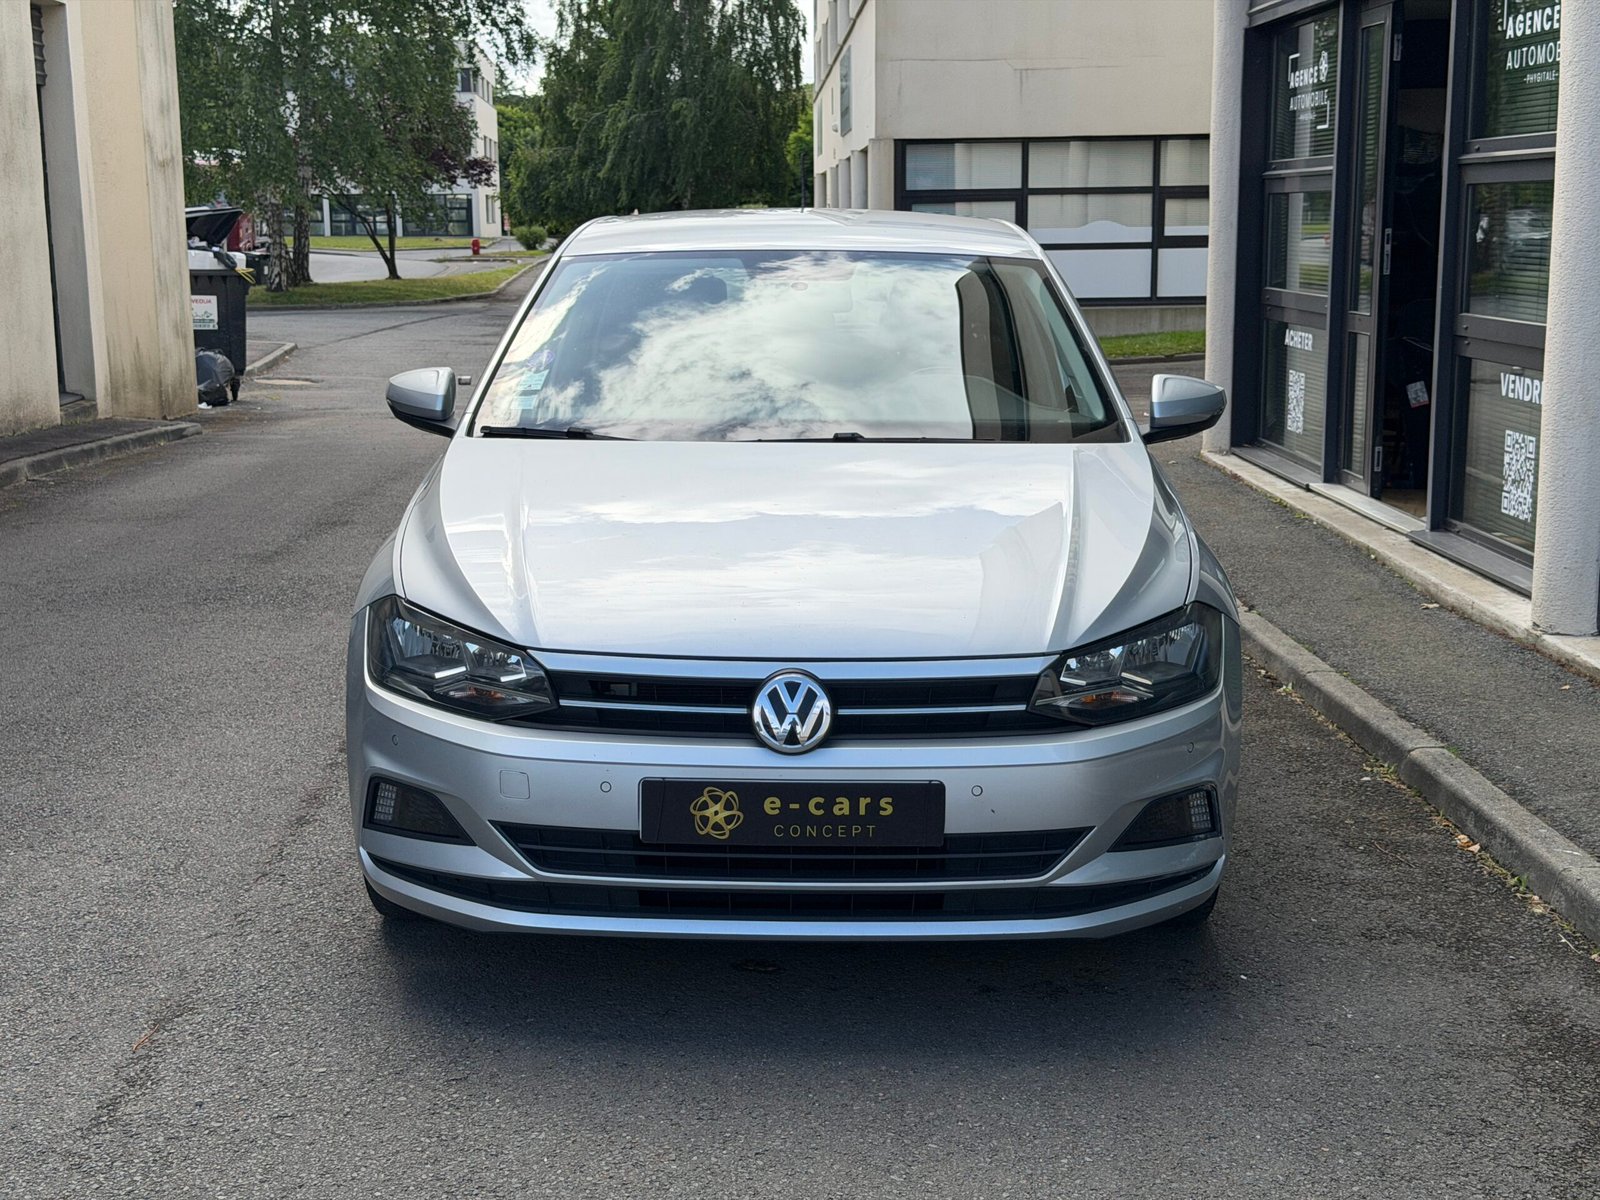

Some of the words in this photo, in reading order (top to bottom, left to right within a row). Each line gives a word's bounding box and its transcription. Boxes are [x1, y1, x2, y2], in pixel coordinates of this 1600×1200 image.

[1505, 4, 1561, 39] AGENCE
[1289, 66, 1319, 89] AGENCE
[1289, 88, 1328, 111] AUTOMOBILE
[1284, 328, 1313, 351] ACHETER
[763, 795, 894, 816] e-cars
[774, 825, 876, 837] CONCEPT
